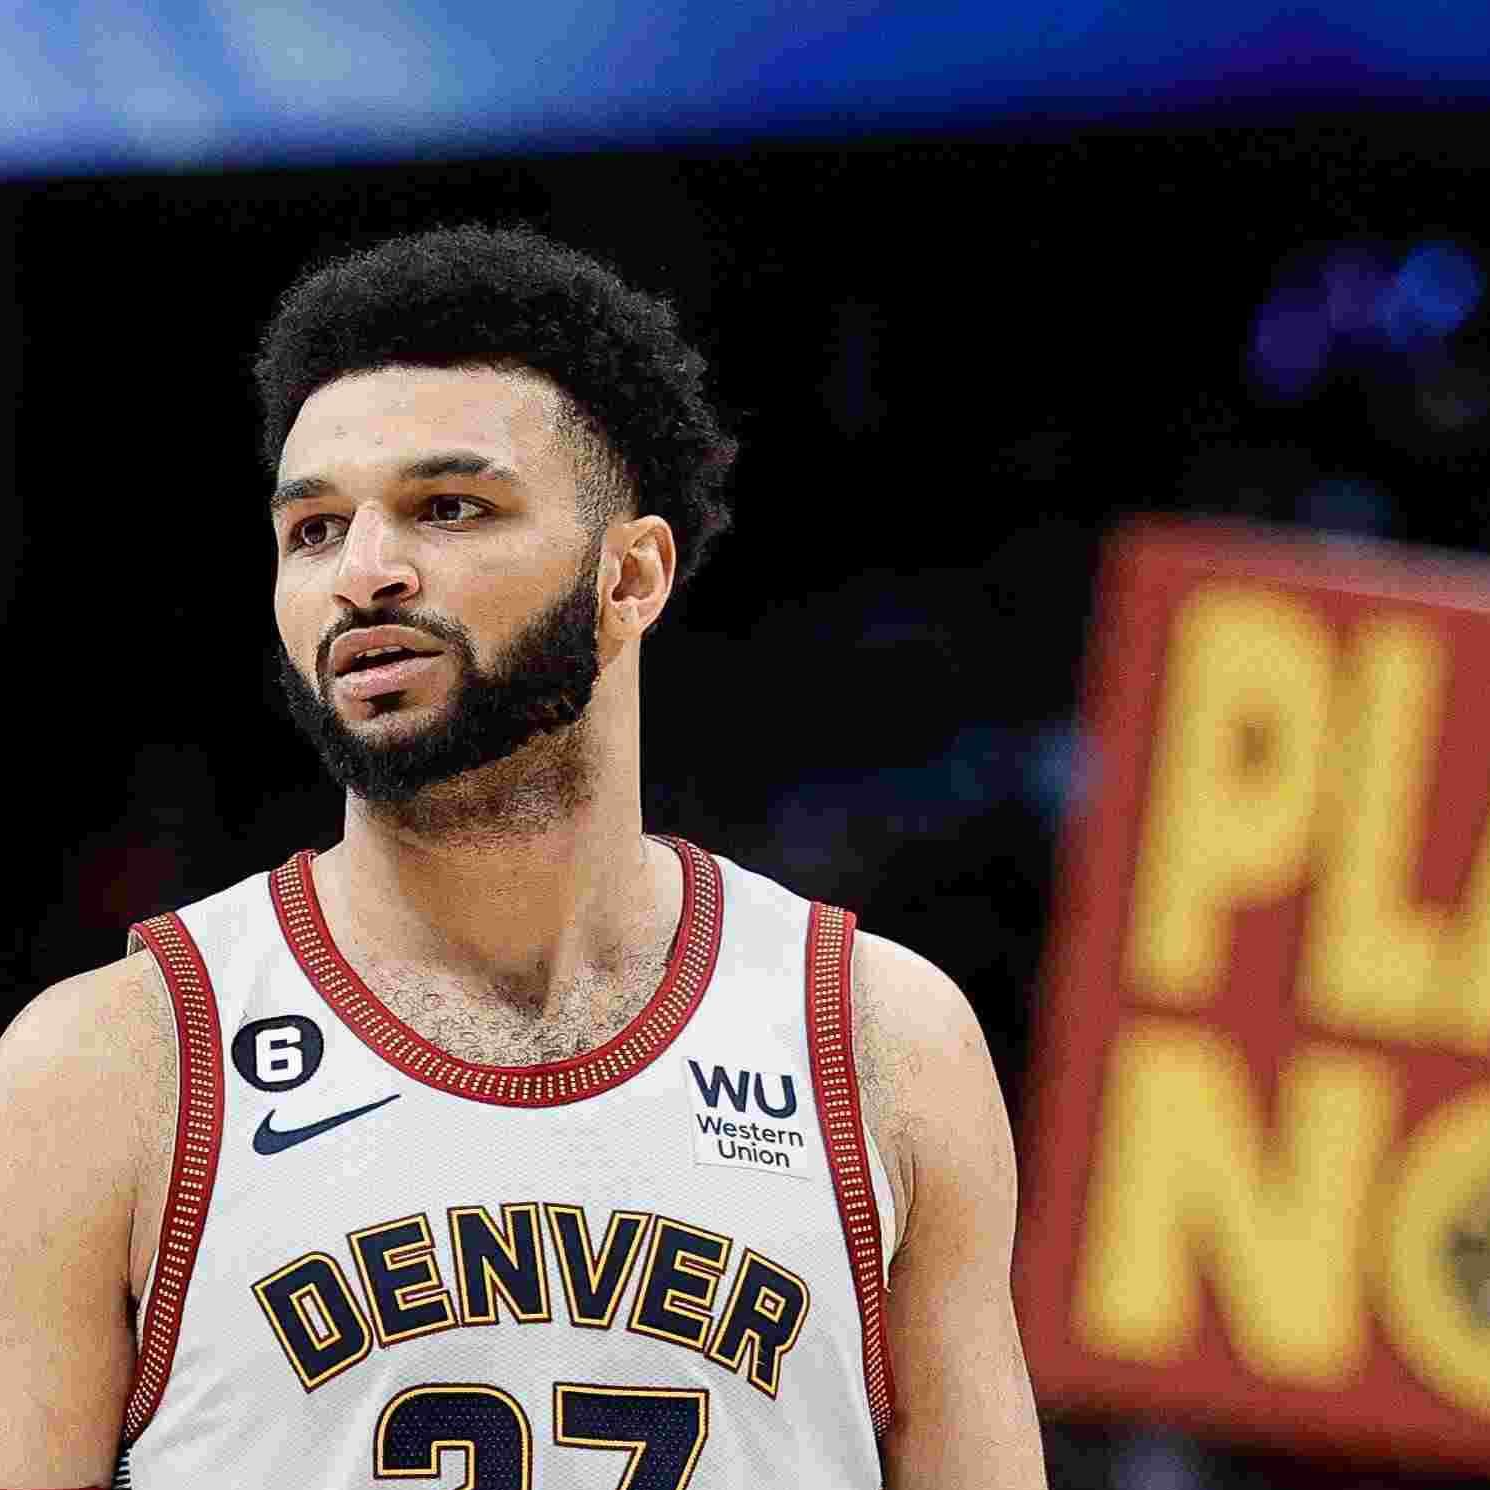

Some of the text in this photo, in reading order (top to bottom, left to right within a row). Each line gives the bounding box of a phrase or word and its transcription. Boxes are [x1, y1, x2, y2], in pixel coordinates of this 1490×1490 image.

[254, 1025, 304, 1083] 6
[688, 1059, 797, 1119] WU
[695, 1113, 805, 1148] Western
[718, 1139, 791, 1168] Union
[251, 1201, 813, 1400] DENVER
